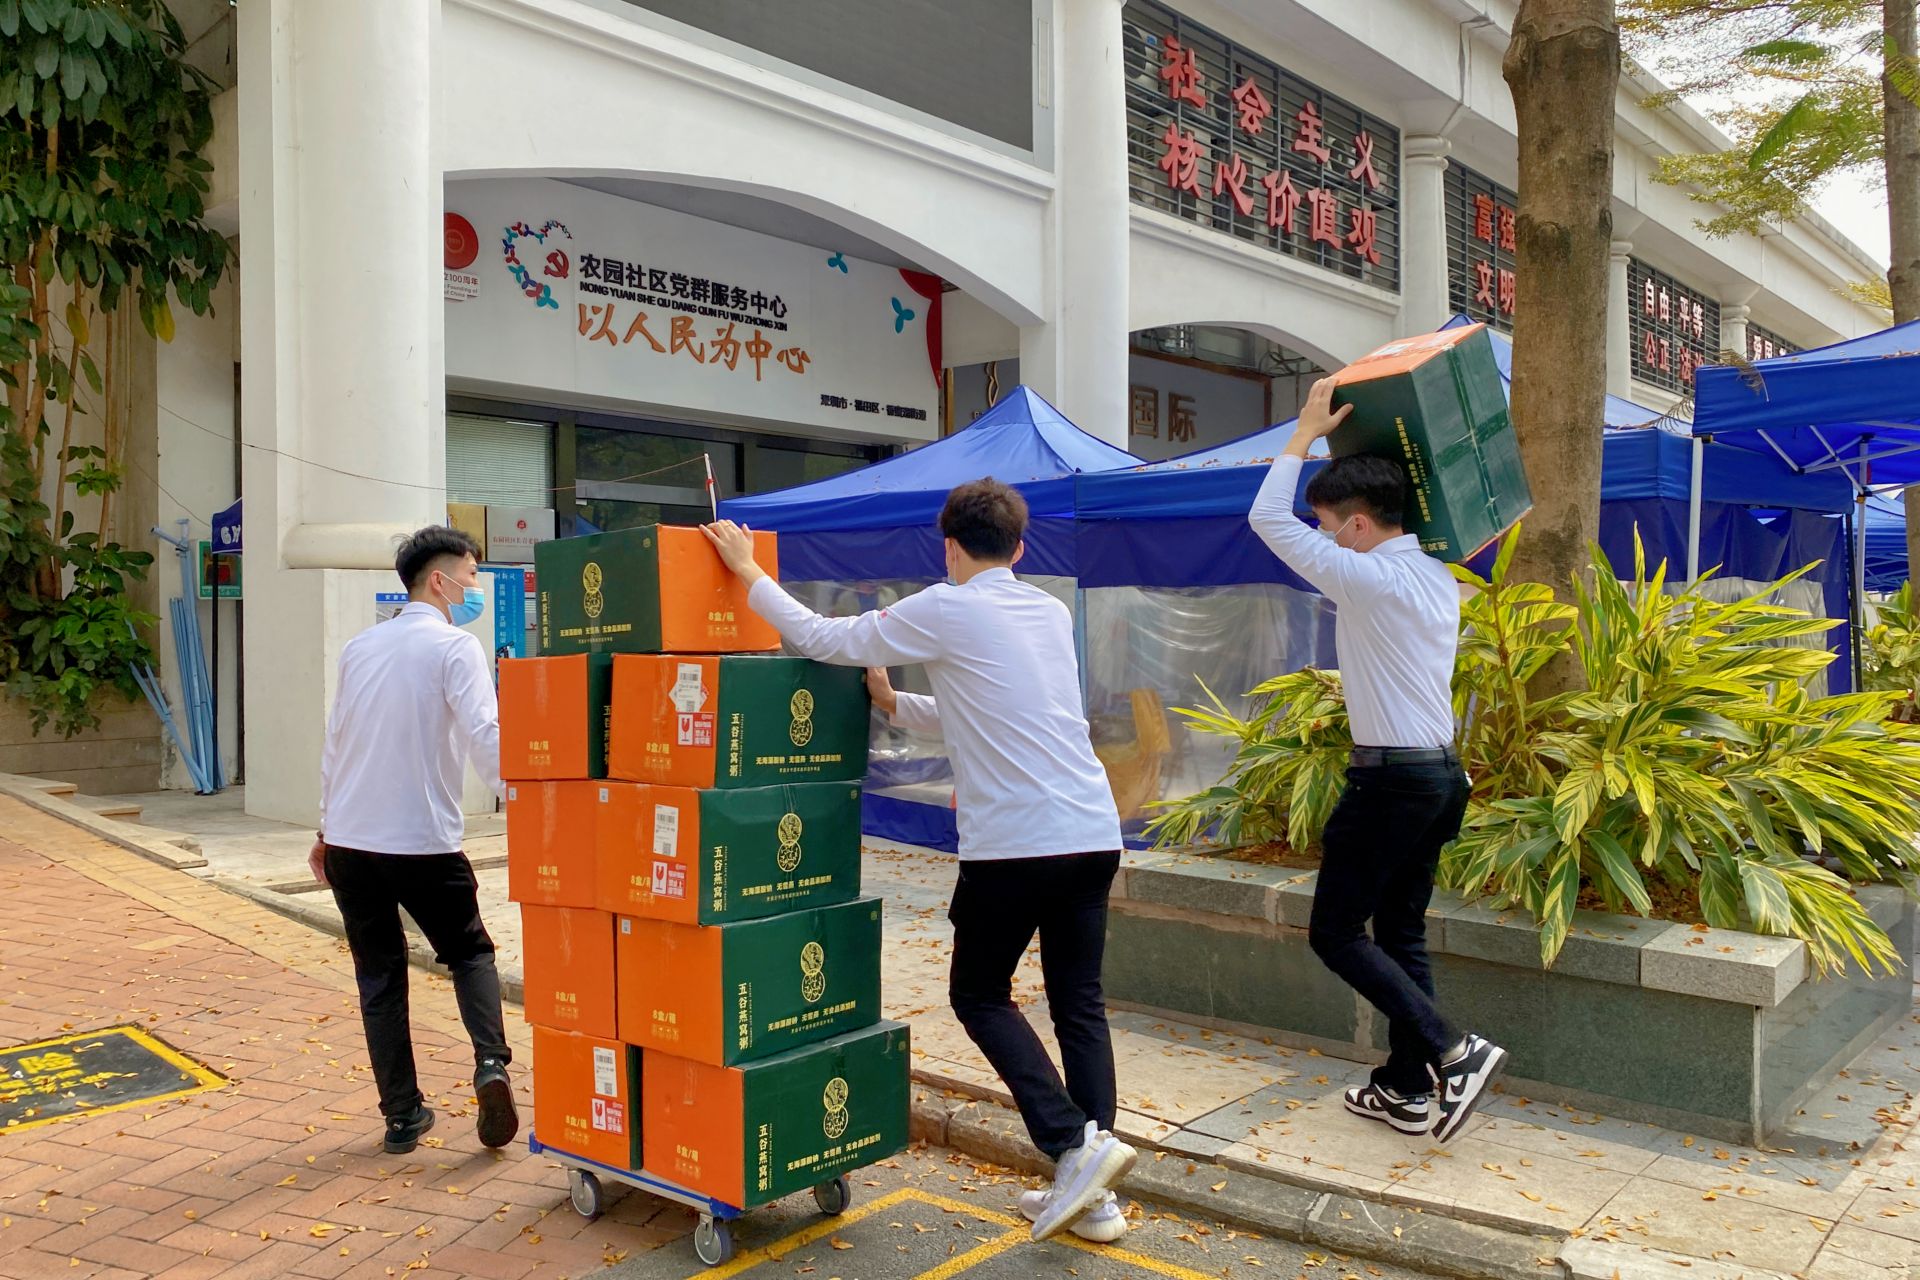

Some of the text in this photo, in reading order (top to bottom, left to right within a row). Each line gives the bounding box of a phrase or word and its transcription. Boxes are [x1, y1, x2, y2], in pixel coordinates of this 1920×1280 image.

[1159, 33, 1381, 190] 社会主义
[1159, 121, 1381, 266] 核心价值观
[579, 253, 788, 319] 农园社区党群服务中心
[579, 281, 788, 332] NONG YUAN SHE QU DANG QUN FU WU ZHONG XIN
[1474, 260, 1515, 316] 文明
[1644, 278, 1703, 340] 自由 平等
[577, 303, 811, 382] 以人民为中心
[1644, 331, 1670, 373] 公正
[1131, 384, 1198, 443] 国际
[713, 845, 723, 912] 五谷燕窝粥
[738, 982, 749, 1051] 五谷燕窝粥
[758, 1124, 768, 1191] 五谷燕窝粥
